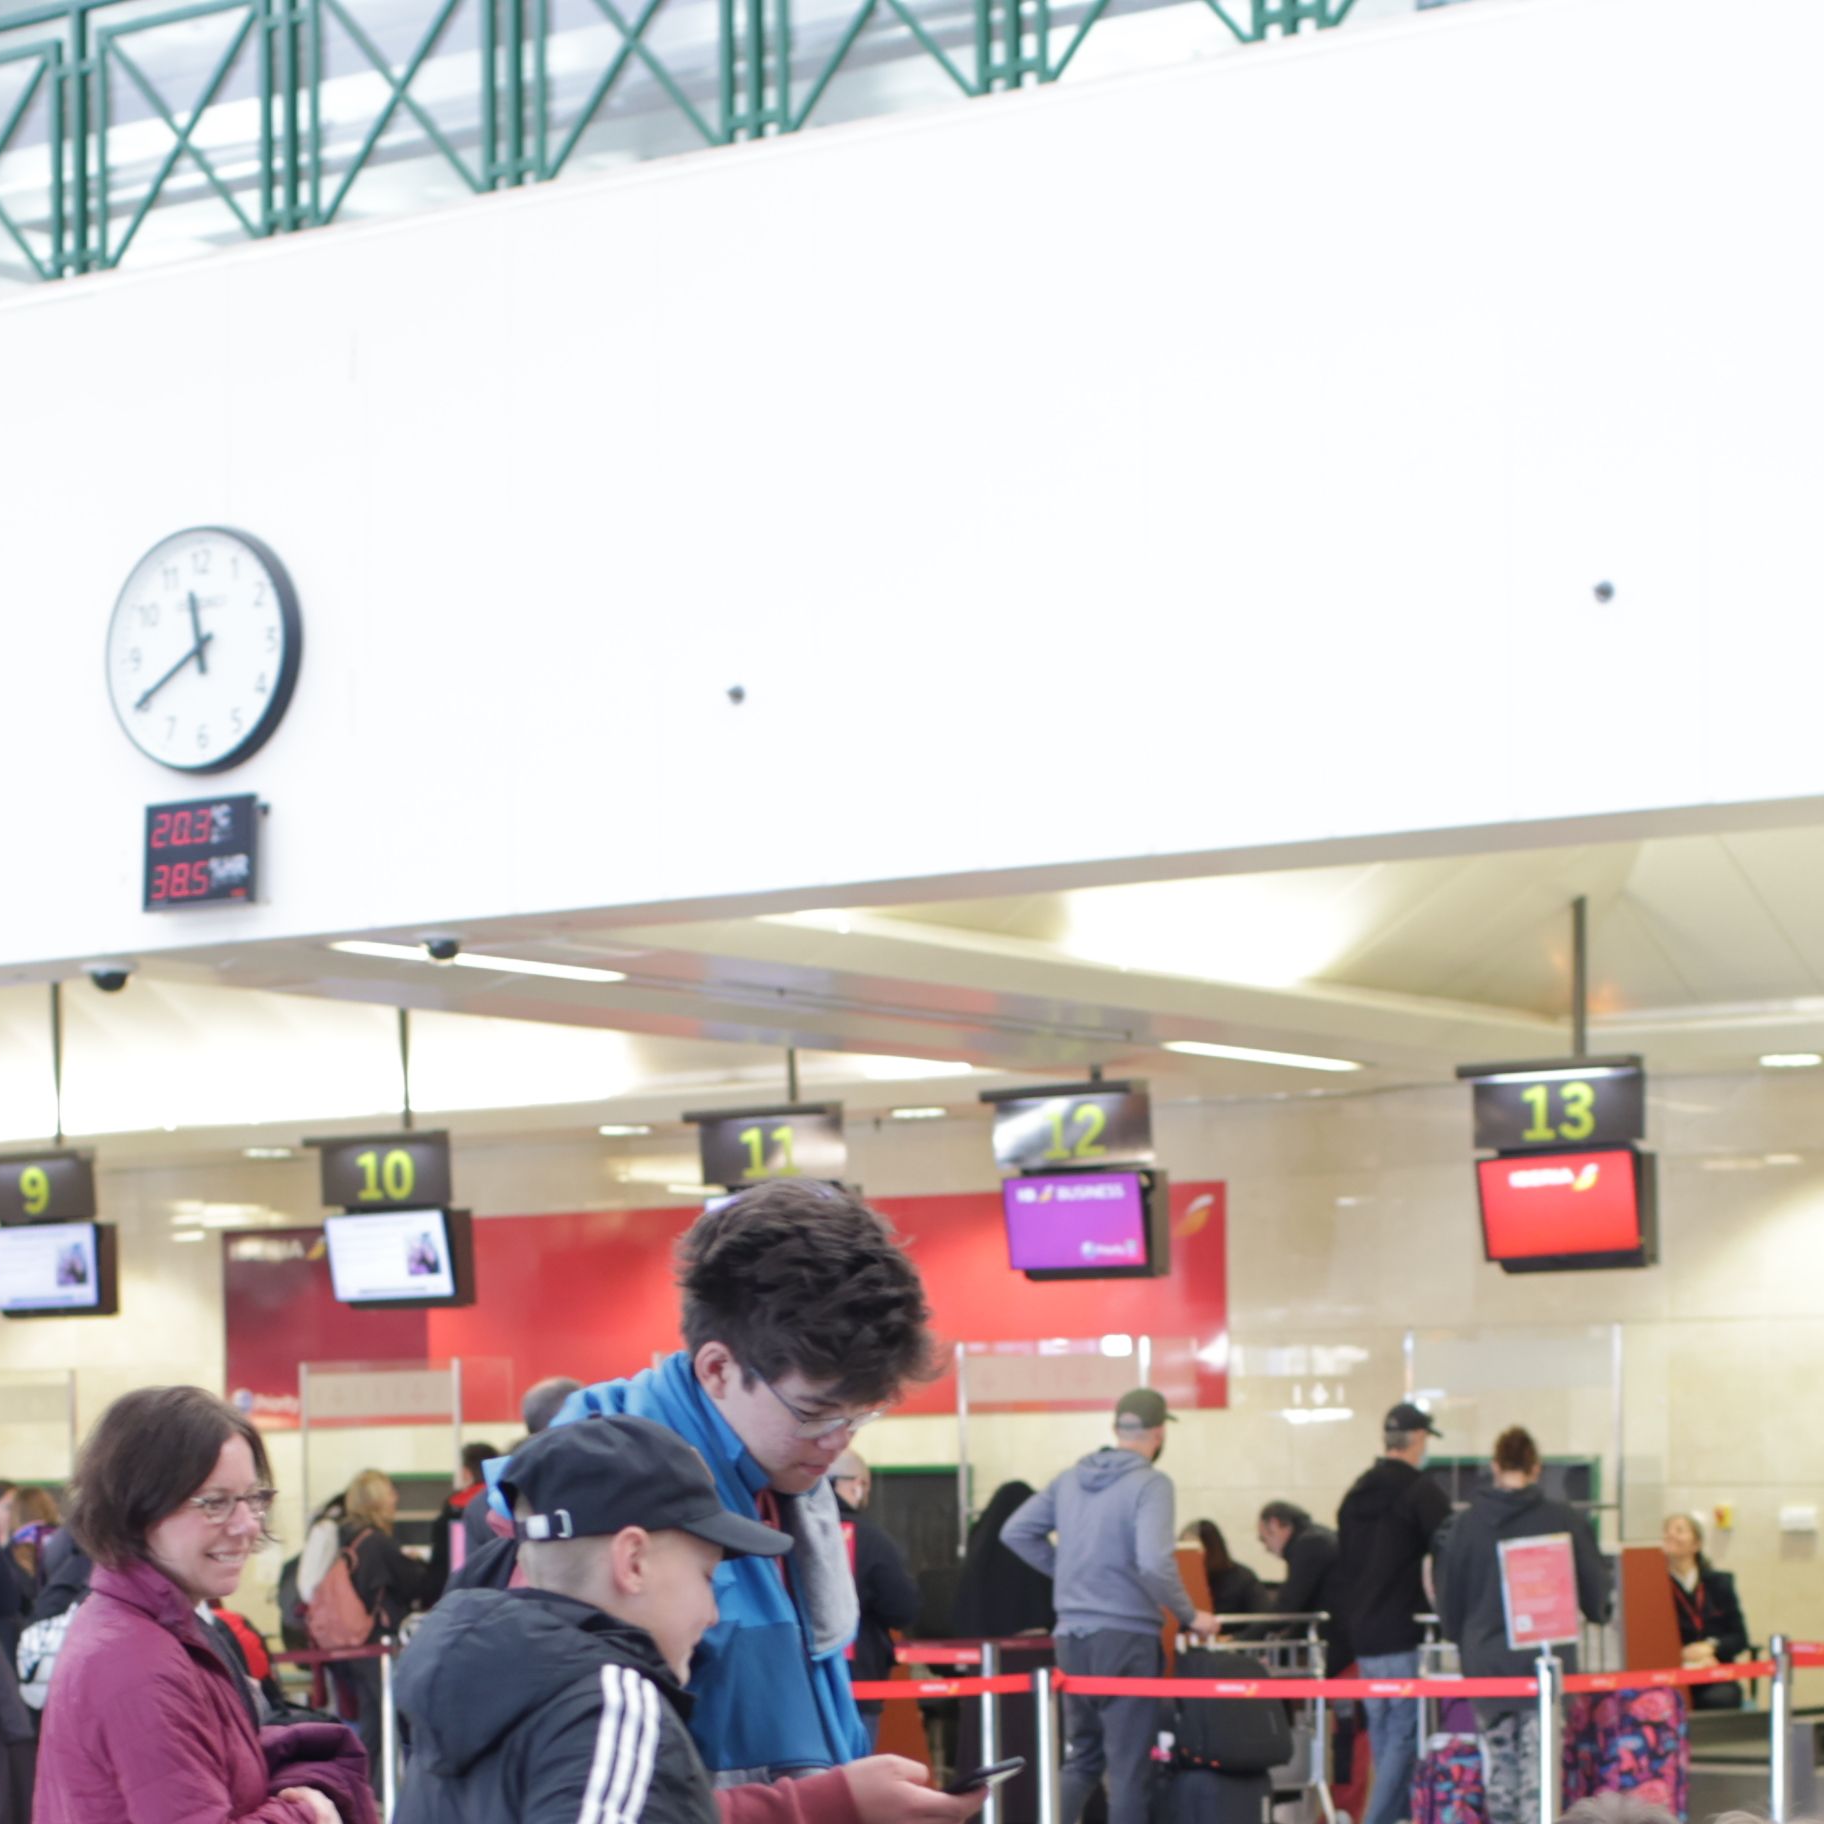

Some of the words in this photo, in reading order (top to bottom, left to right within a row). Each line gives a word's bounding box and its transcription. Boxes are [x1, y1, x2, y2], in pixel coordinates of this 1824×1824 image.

[191, 549, 211, 575] 12
[162, 567, 179, 591] 11
[253, 582, 267, 607] 2
[139, 603, 160, 627] 10
[265, 627, 277, 651] 3
[130, 648, 142, 671] 9
[255, 672, 266, 694] 4
[165, 716, 177, 741] 7
[230, 708, 243, 733] 5
[197, 725, 209, 749] 6
[1520, 1082, 1596, 1142] 13
[1041, 1102, 1107, 1161] 12
[739, 1124, 801, 1180] 11
[355, 1148, 416, 1202] 10
[18, 1166, 51, 1215] 9
